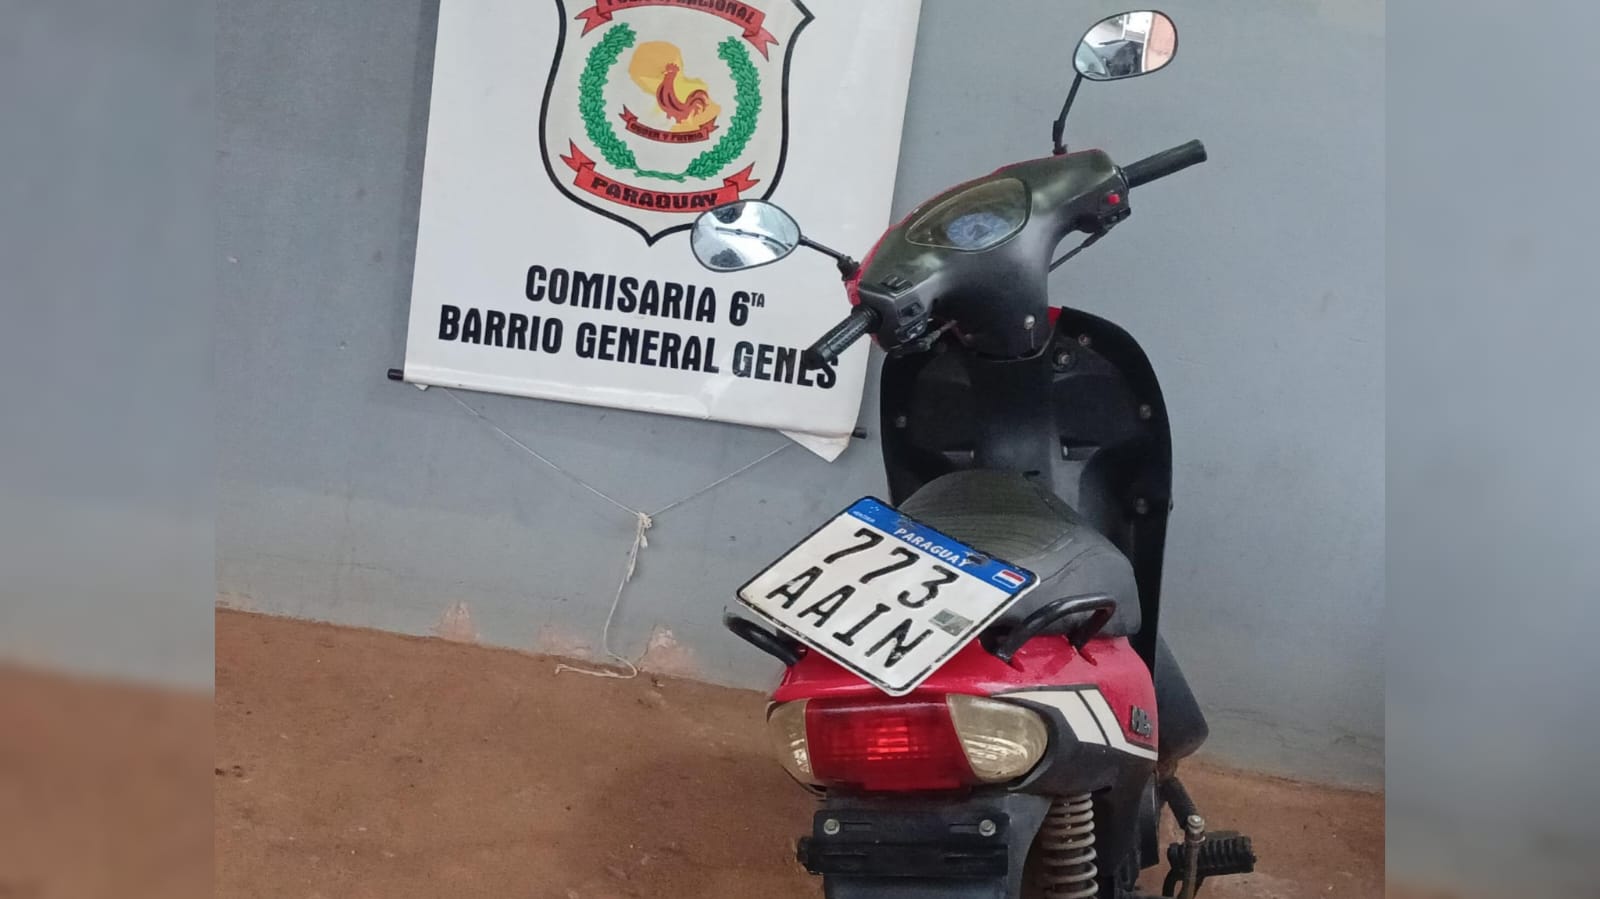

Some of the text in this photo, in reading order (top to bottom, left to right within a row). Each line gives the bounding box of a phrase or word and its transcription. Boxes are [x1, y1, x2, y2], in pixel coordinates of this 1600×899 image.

[677, 0, 755, 24] CIONAL
[591, 177, 718, 209] PARAGUAY
[525, 265, 716, 323] COMISARIA
[438, 304, 839, 389] BARRIO GENERAL GENES
[823, 528, 960, 608] 773
[893, 527, 974, 568] PARAGUAY
[765, 566, 934, 668] AAIN
